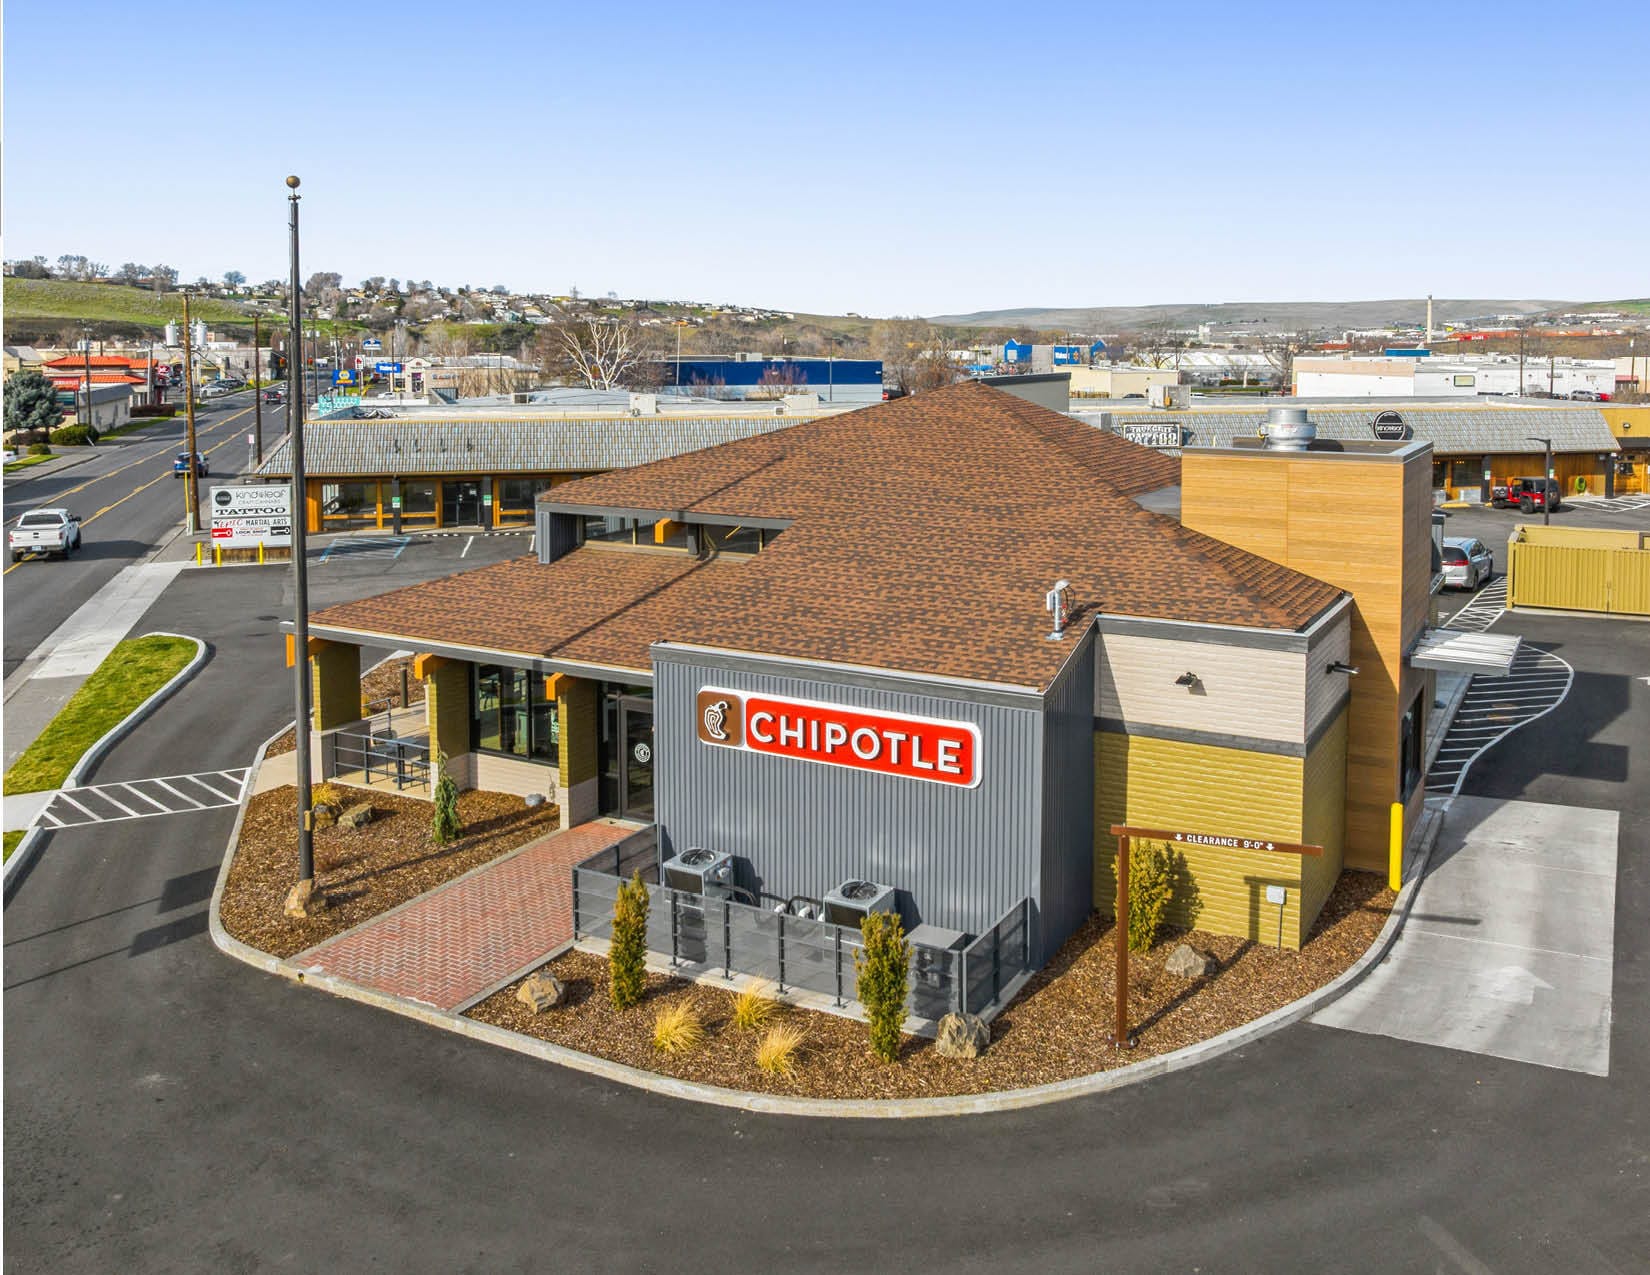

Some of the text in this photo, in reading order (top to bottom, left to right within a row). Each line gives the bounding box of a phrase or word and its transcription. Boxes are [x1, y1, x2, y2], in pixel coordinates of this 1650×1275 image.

[1126, 432, 1177, 445] TATTOO
[235, 490, 258, 499] kind
[265, 489, 286, 499] leaf
[215, 507, 286, 516] TATTOO
[750, 711, 961, 774] CHIPOTLE
[1186, 834, 1239, 847] CLEARANCE
